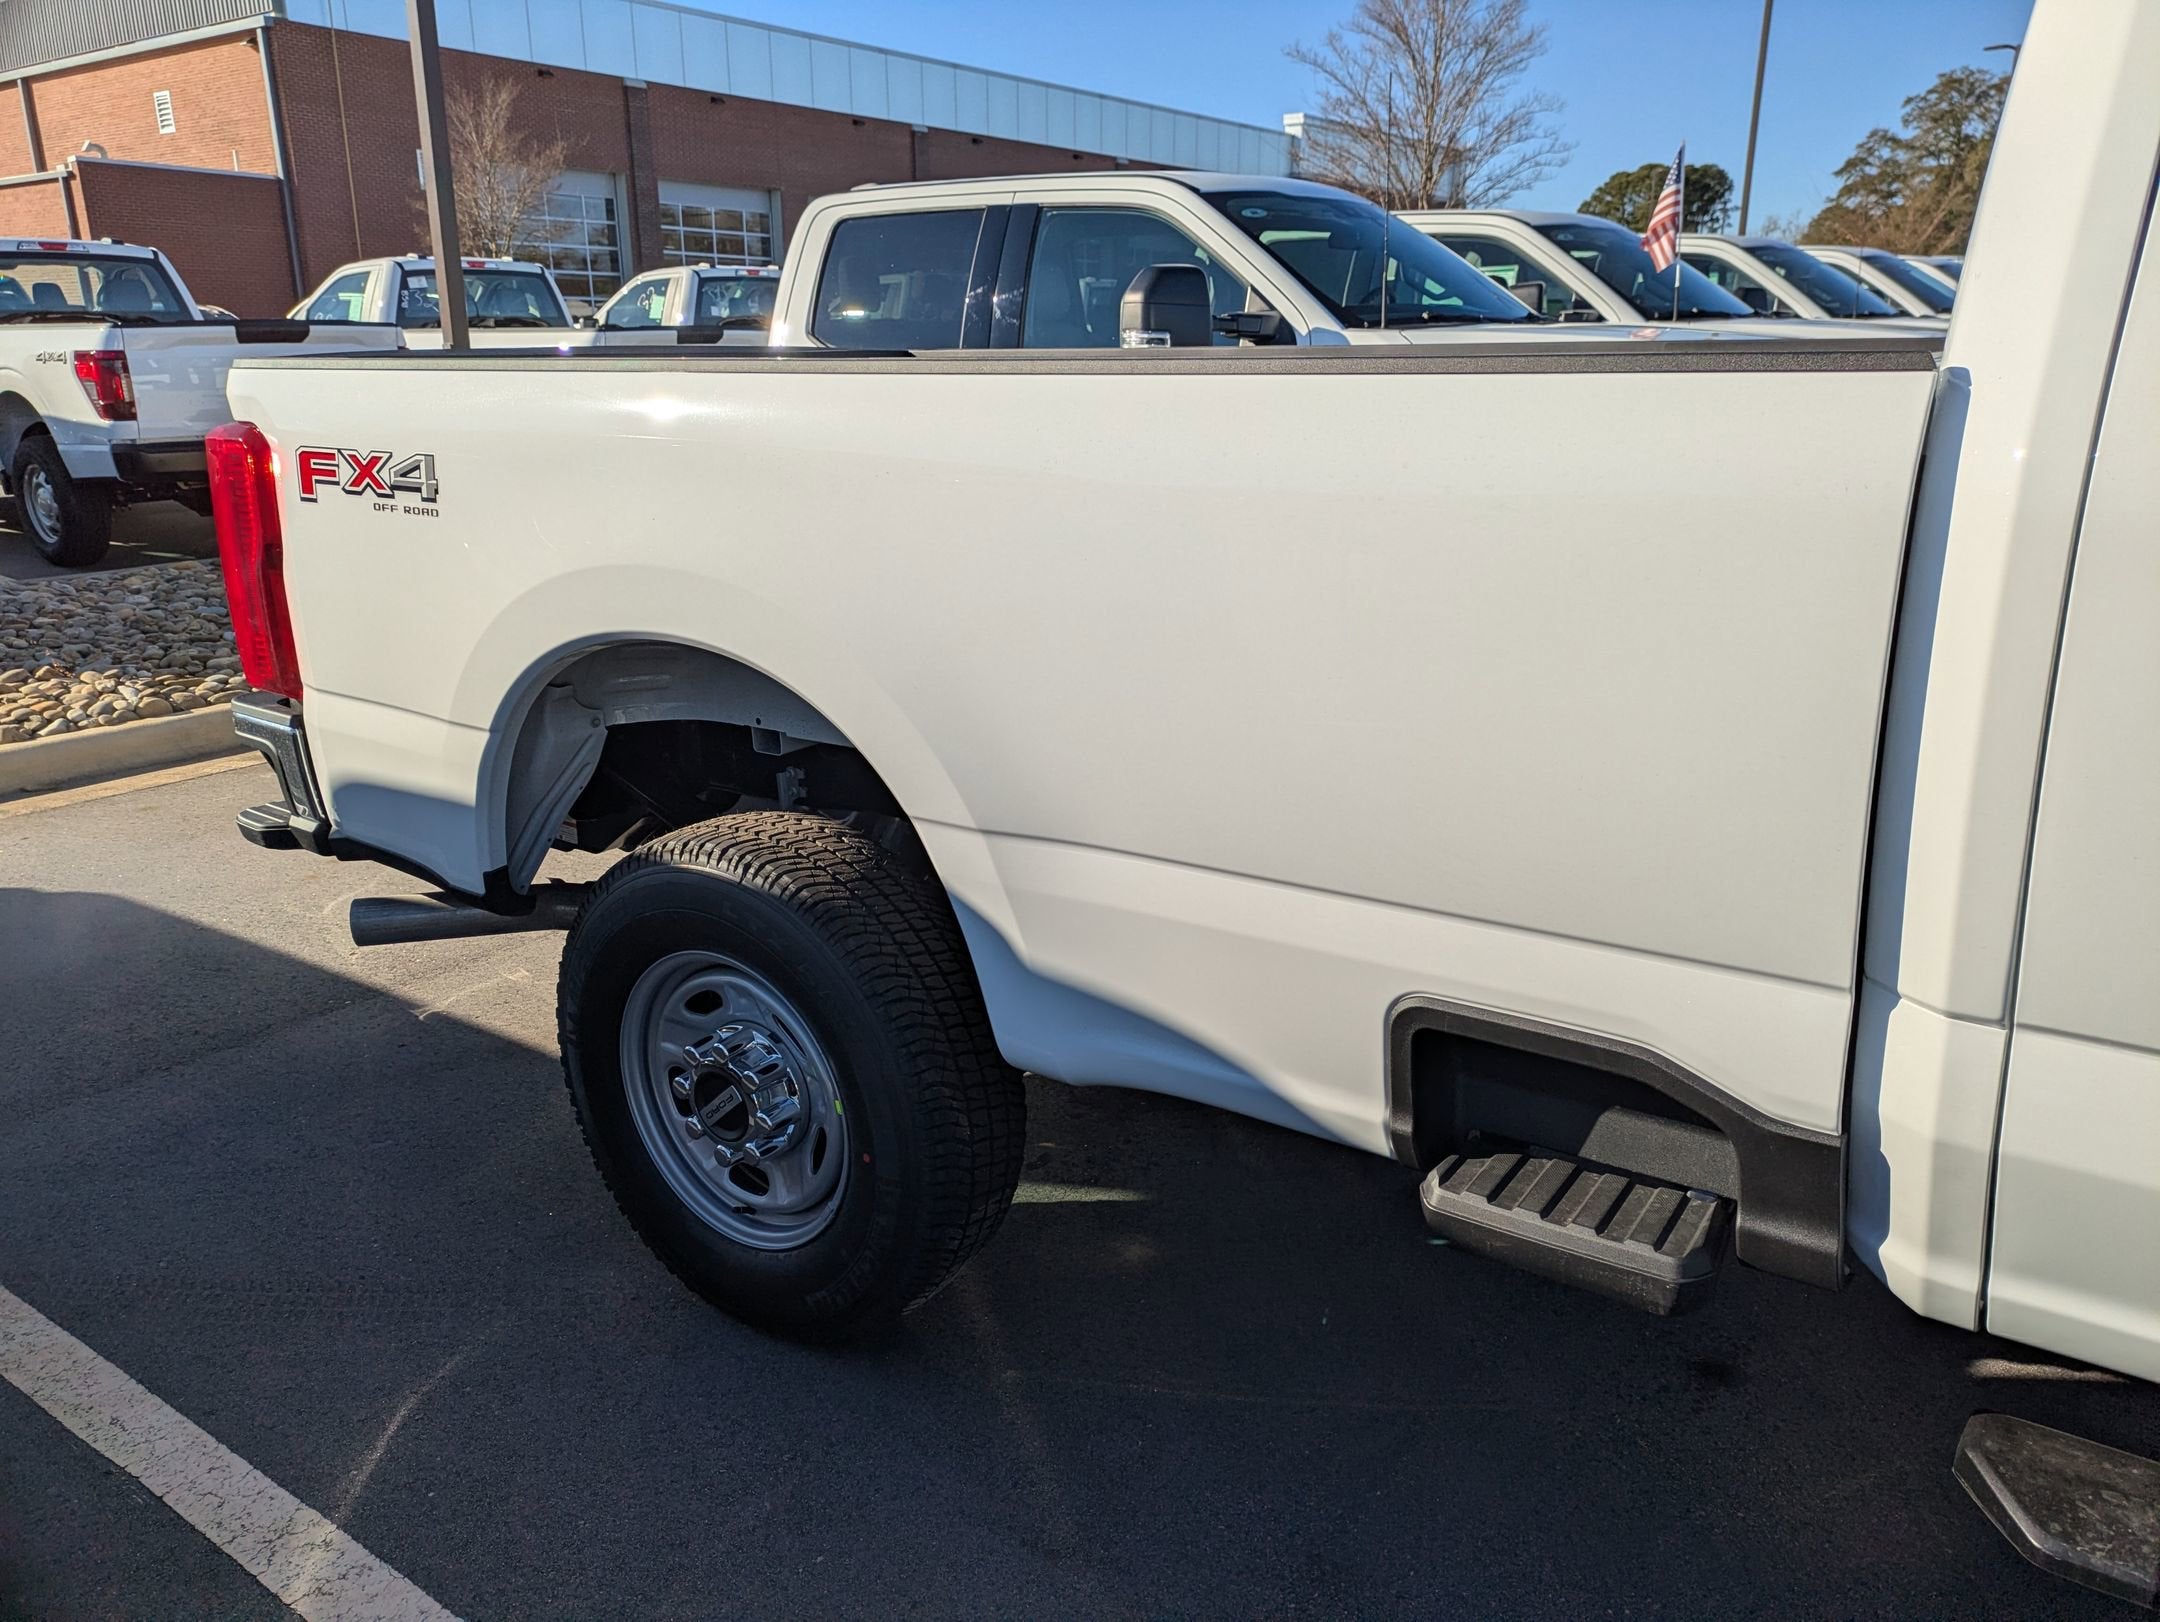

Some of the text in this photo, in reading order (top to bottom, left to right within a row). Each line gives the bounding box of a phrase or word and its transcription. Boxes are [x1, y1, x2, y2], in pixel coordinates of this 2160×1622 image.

[295, 445, 439, 504] FX4
[373, 502, 439, 518] OFF ROAD
[705, 1093, 734, 1120] FORD
